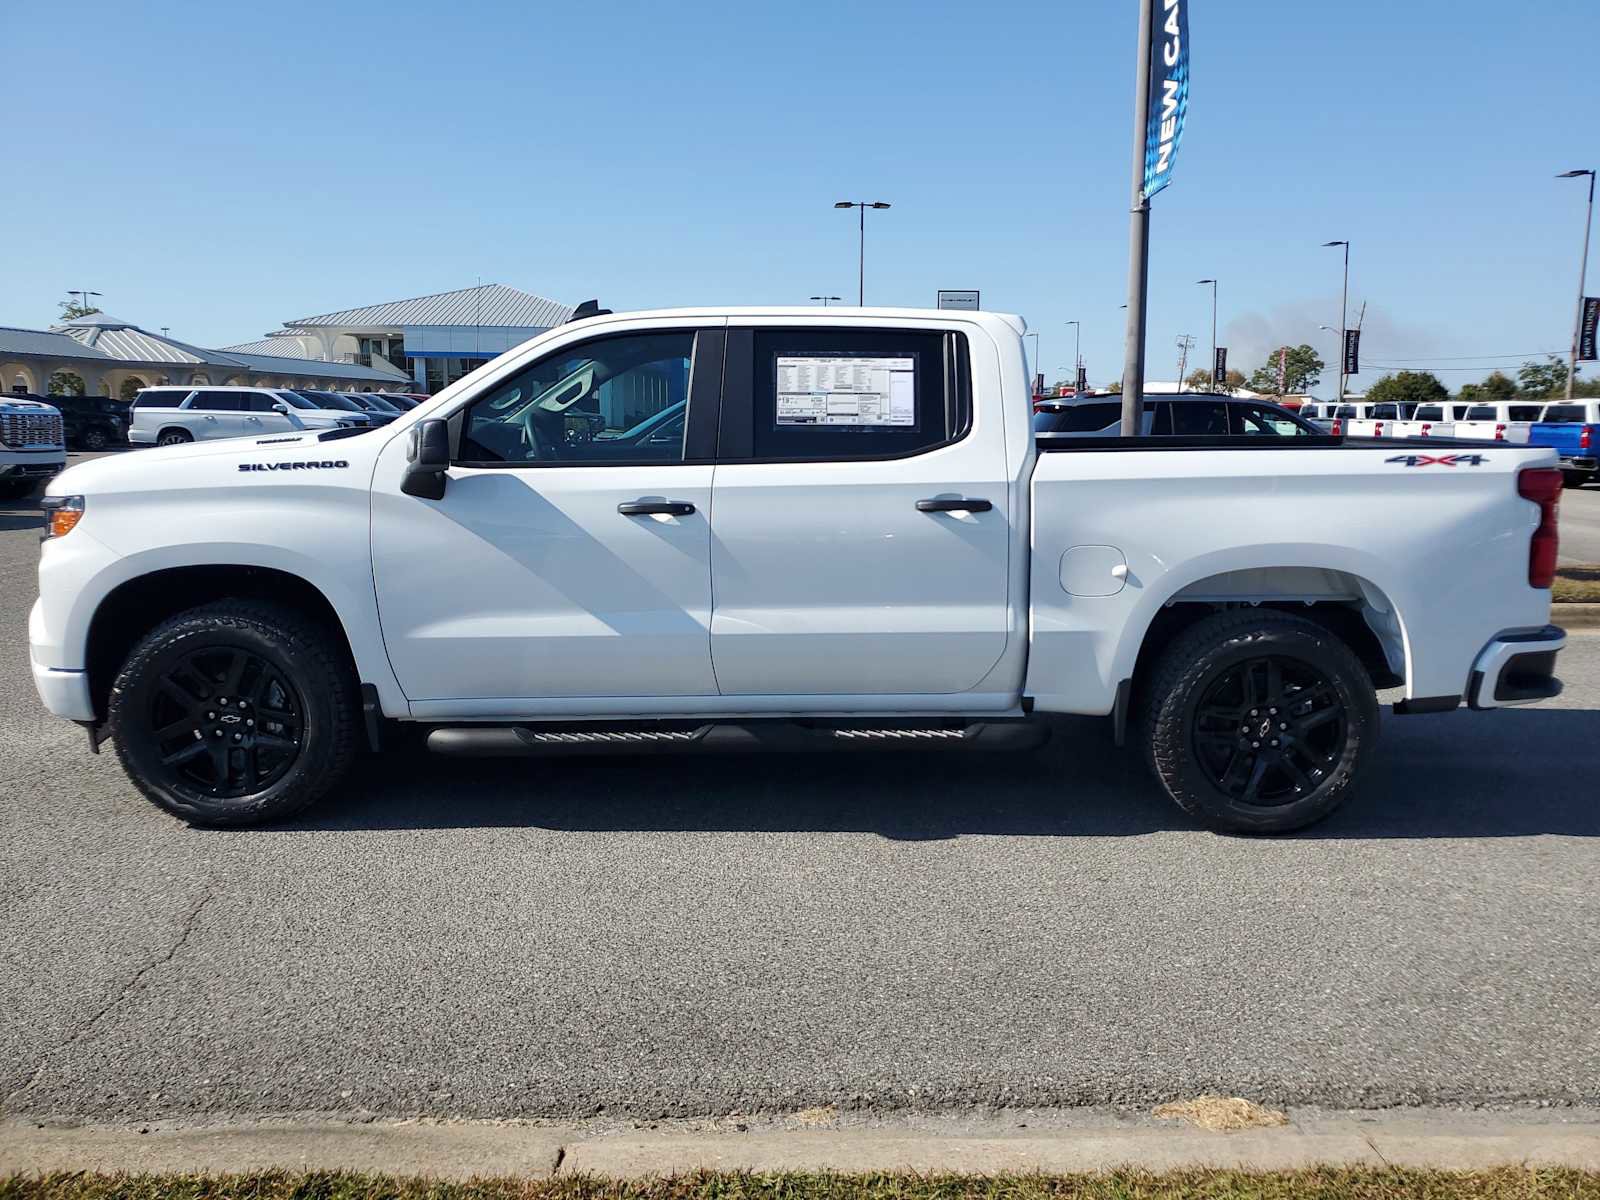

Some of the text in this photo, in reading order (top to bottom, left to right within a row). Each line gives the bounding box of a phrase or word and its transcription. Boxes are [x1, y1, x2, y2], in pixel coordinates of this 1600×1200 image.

[1156, 79, 1179, 174] NEW
[1583, 300, 1597, 357] NEW TRUCKS
[237, 460, 349, 472] SILVERADO
